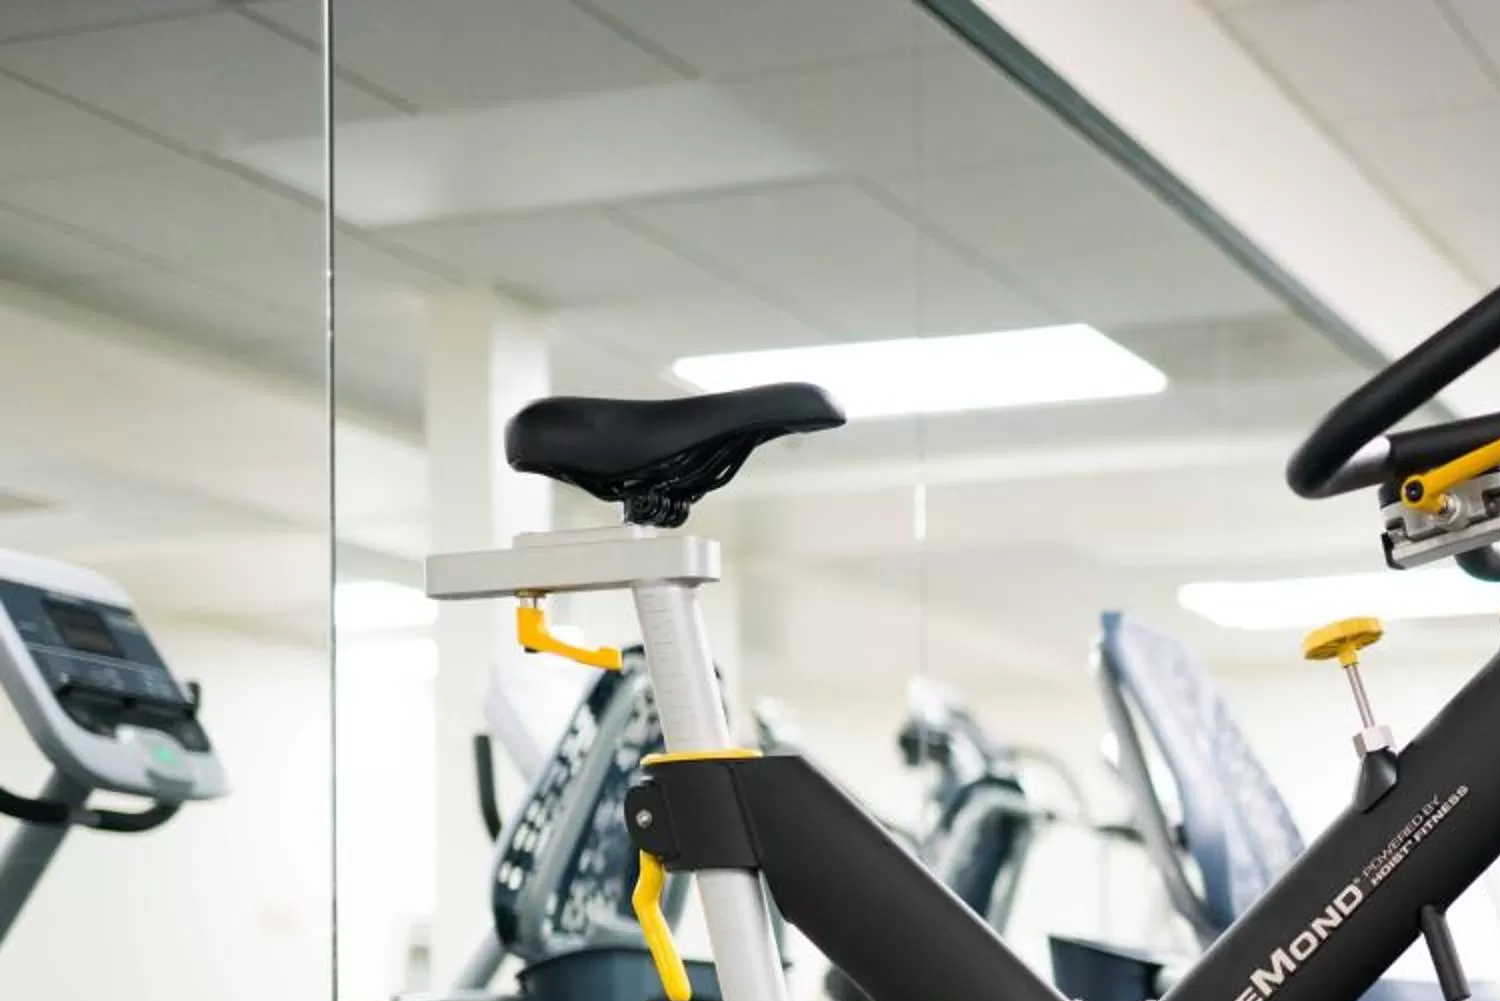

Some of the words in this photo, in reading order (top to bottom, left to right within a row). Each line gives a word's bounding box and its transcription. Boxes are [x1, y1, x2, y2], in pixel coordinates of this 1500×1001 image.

[1363, 813, 1423, 878] POWERED
[1421, 793, 1440, 817] BY
[1413, 785, 1469, 841] FITNESS
